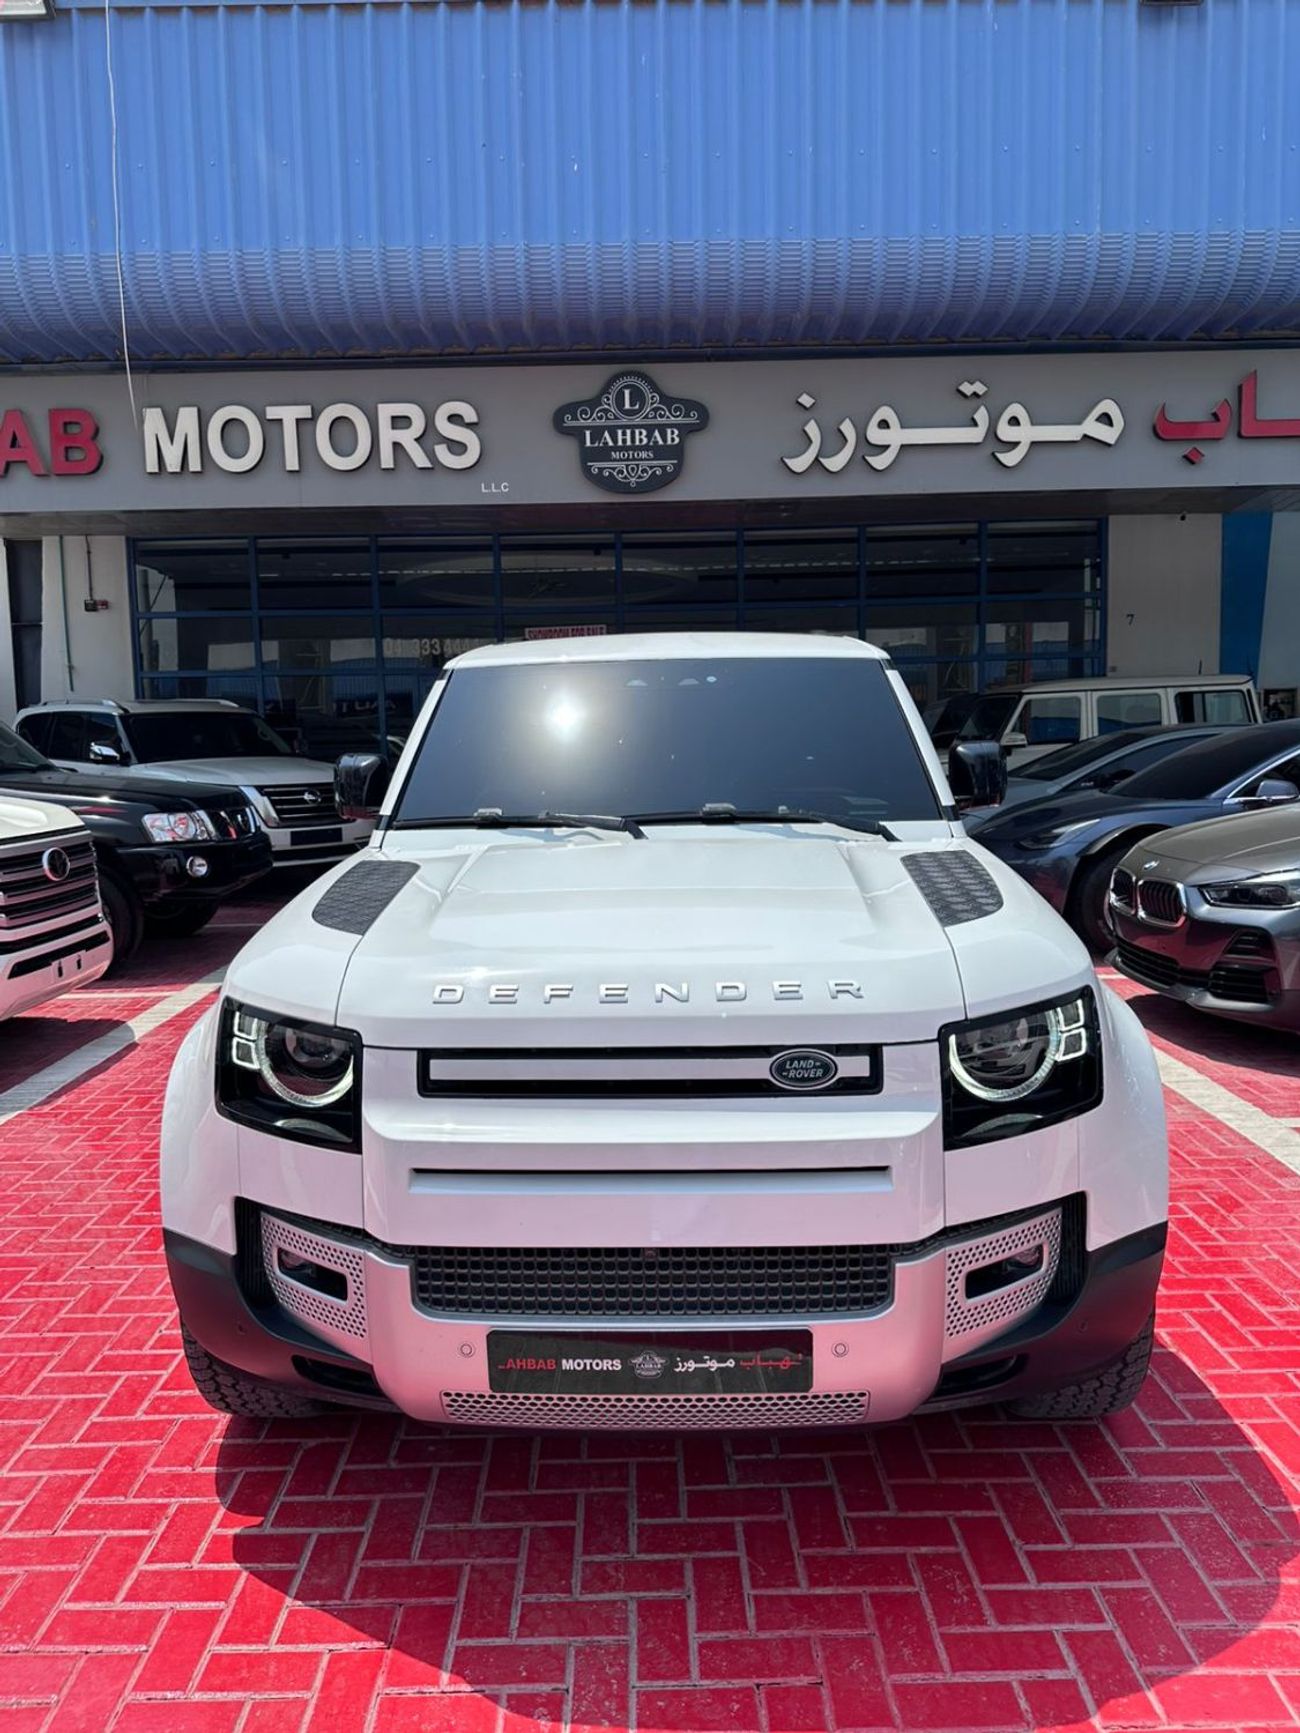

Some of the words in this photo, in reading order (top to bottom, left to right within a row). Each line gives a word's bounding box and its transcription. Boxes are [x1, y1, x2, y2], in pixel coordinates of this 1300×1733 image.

[623, 388, 639, 410] L
[781, 378, 1125, 473] موتورز
[143, 400, 481, 475] MOTORS
[584, 428, 680, 448] LAHBAB
[611, 450, 654, 461] MOTORS
[1126, 613, 1135, 626] 7
[432, 979, 864, 1005] DEFENDER
[497, 1358, 557, 1371] AHBAB
[561, 1358, 622, 1371] MOTORS
[673, 1355, 736, 1372] موتورز
